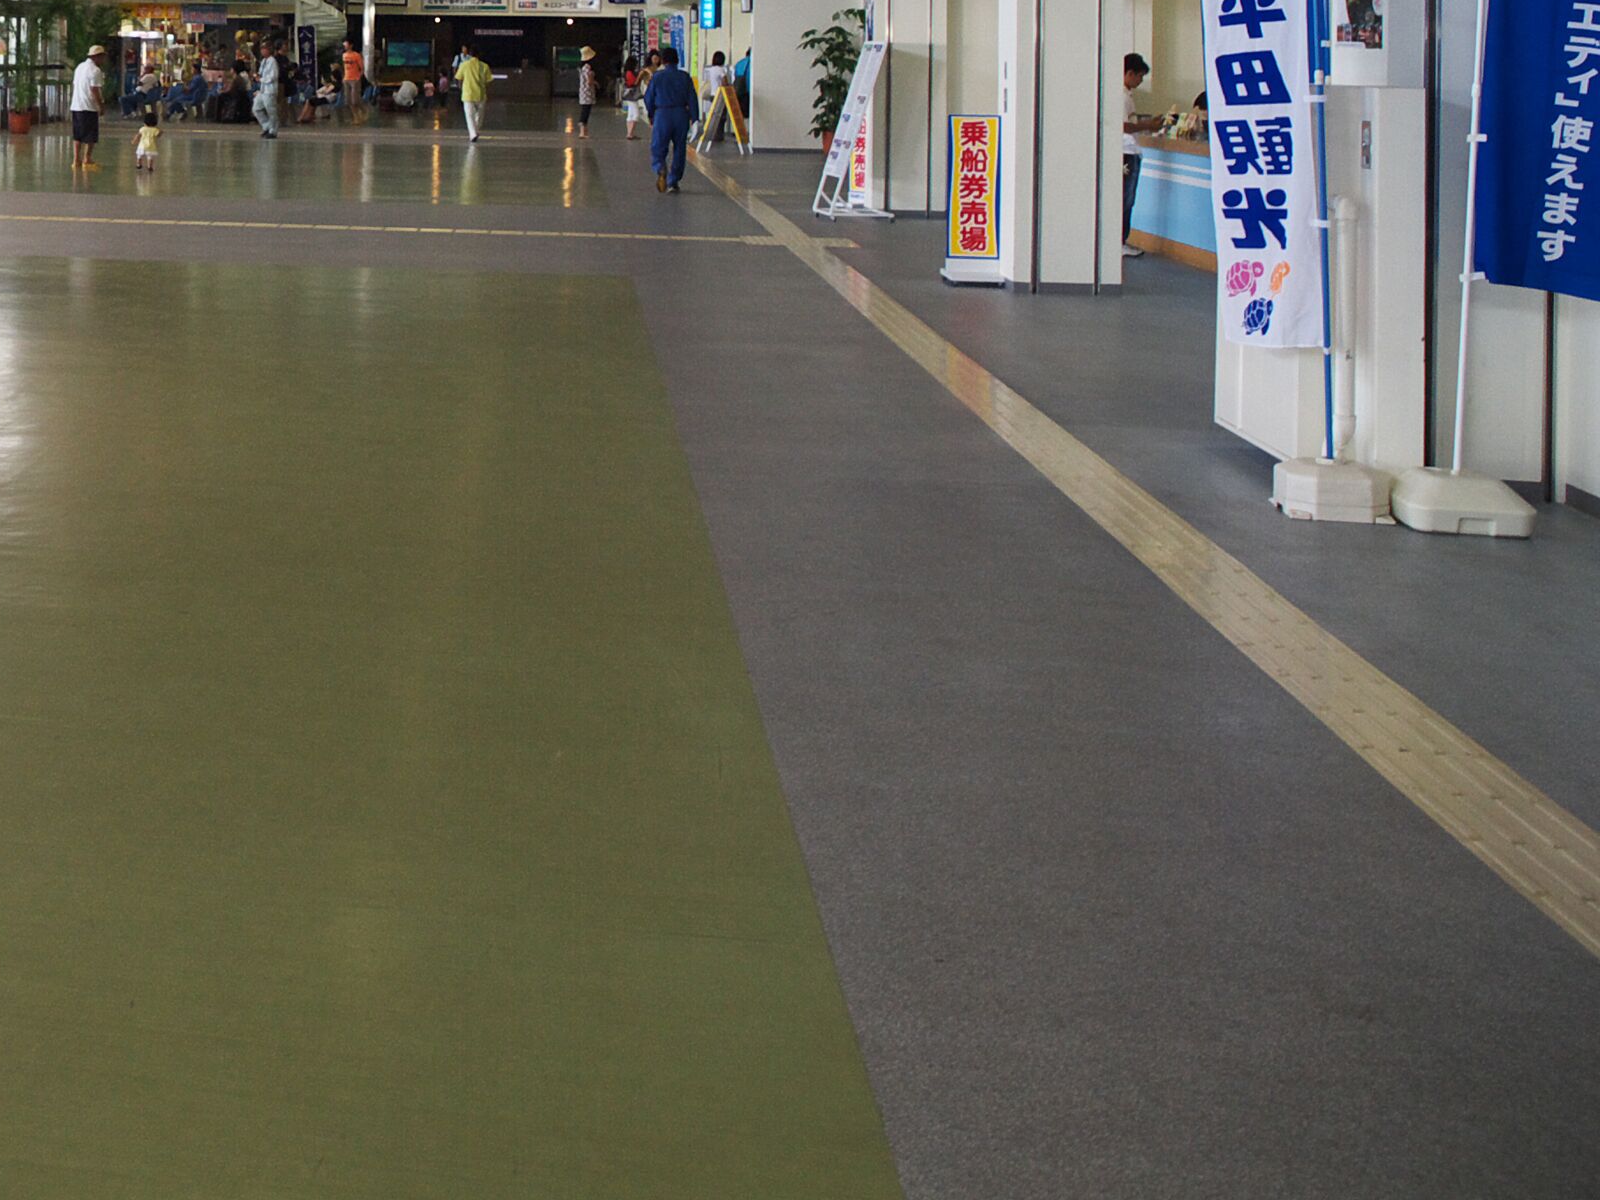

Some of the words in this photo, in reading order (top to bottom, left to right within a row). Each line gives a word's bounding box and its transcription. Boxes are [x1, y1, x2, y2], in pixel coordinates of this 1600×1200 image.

[960, 121, 988, 251] 乗船券売場
